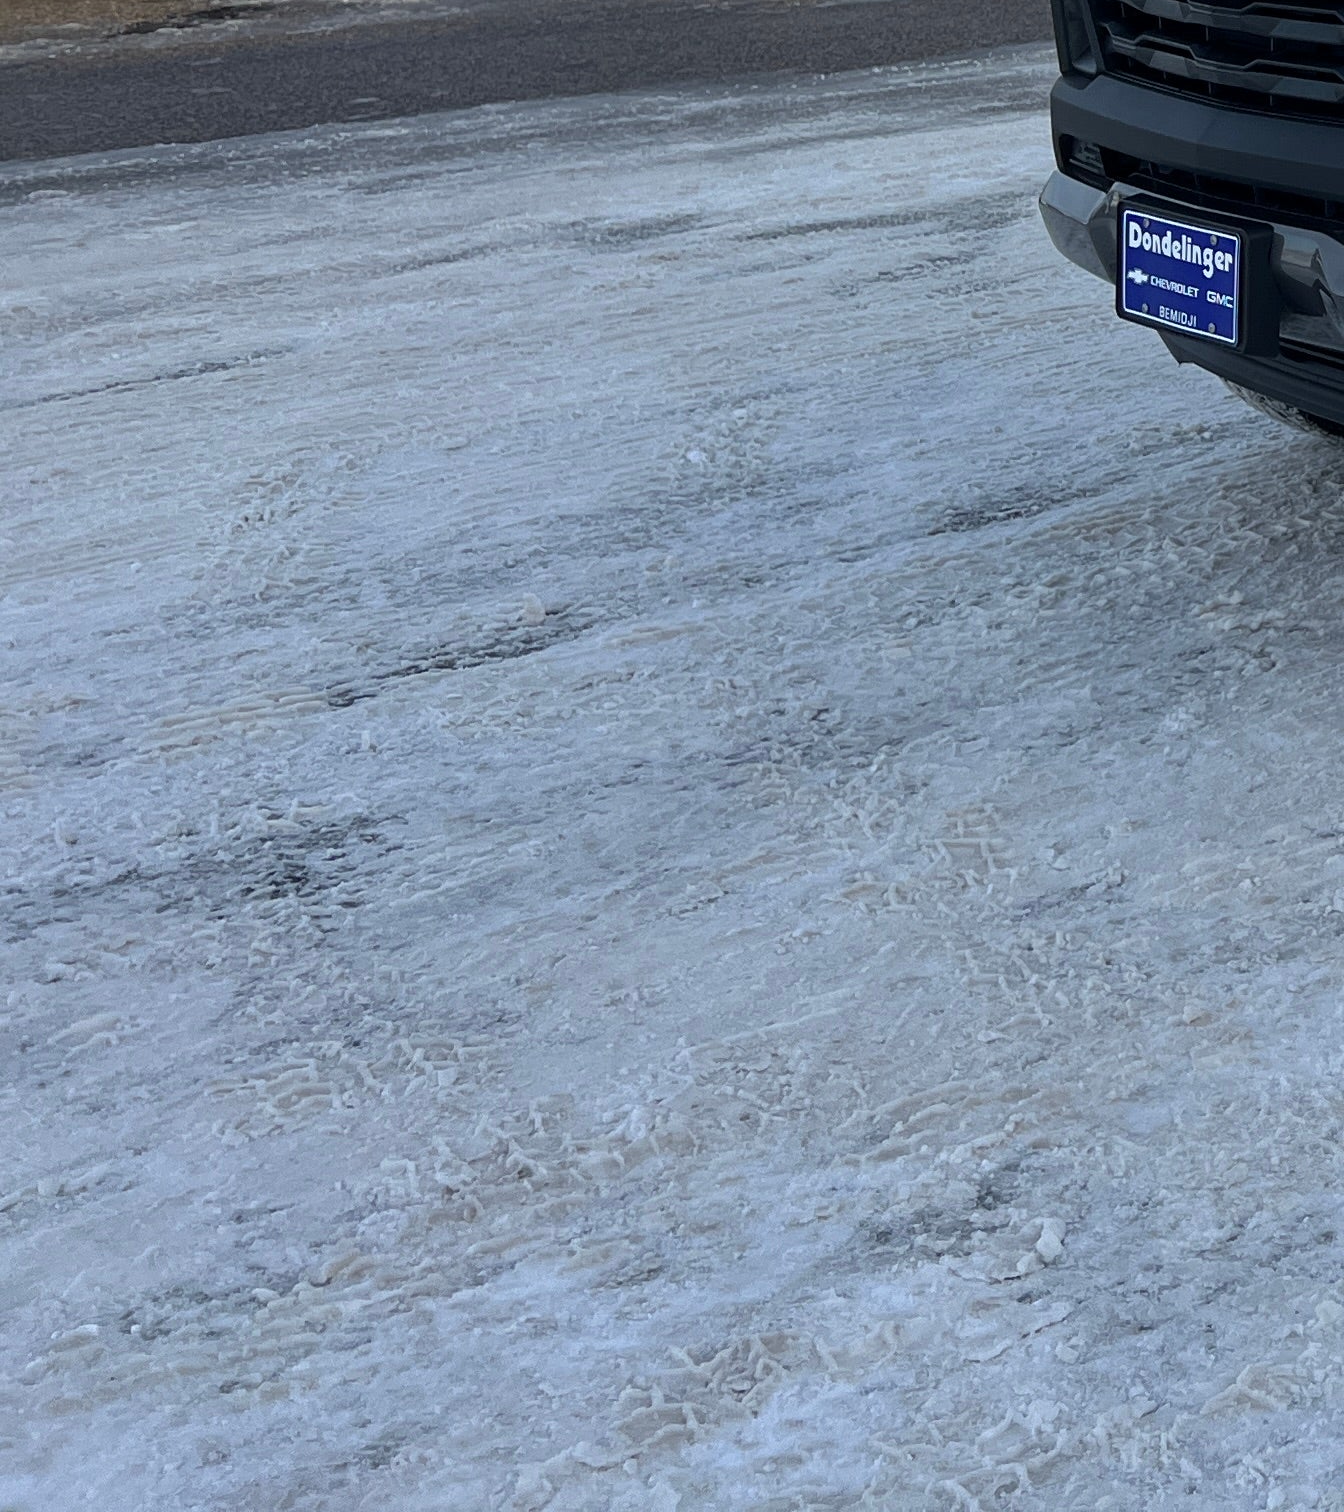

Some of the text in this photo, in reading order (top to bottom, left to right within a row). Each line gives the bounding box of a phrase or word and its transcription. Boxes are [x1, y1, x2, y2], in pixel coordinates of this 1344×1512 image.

[1128, 221, 1233, 279] Dondelinger
[1150, 275, 1234, 308] CHEVROLET GMC
[1159, 305, 1197, 328] BEMIDJI
